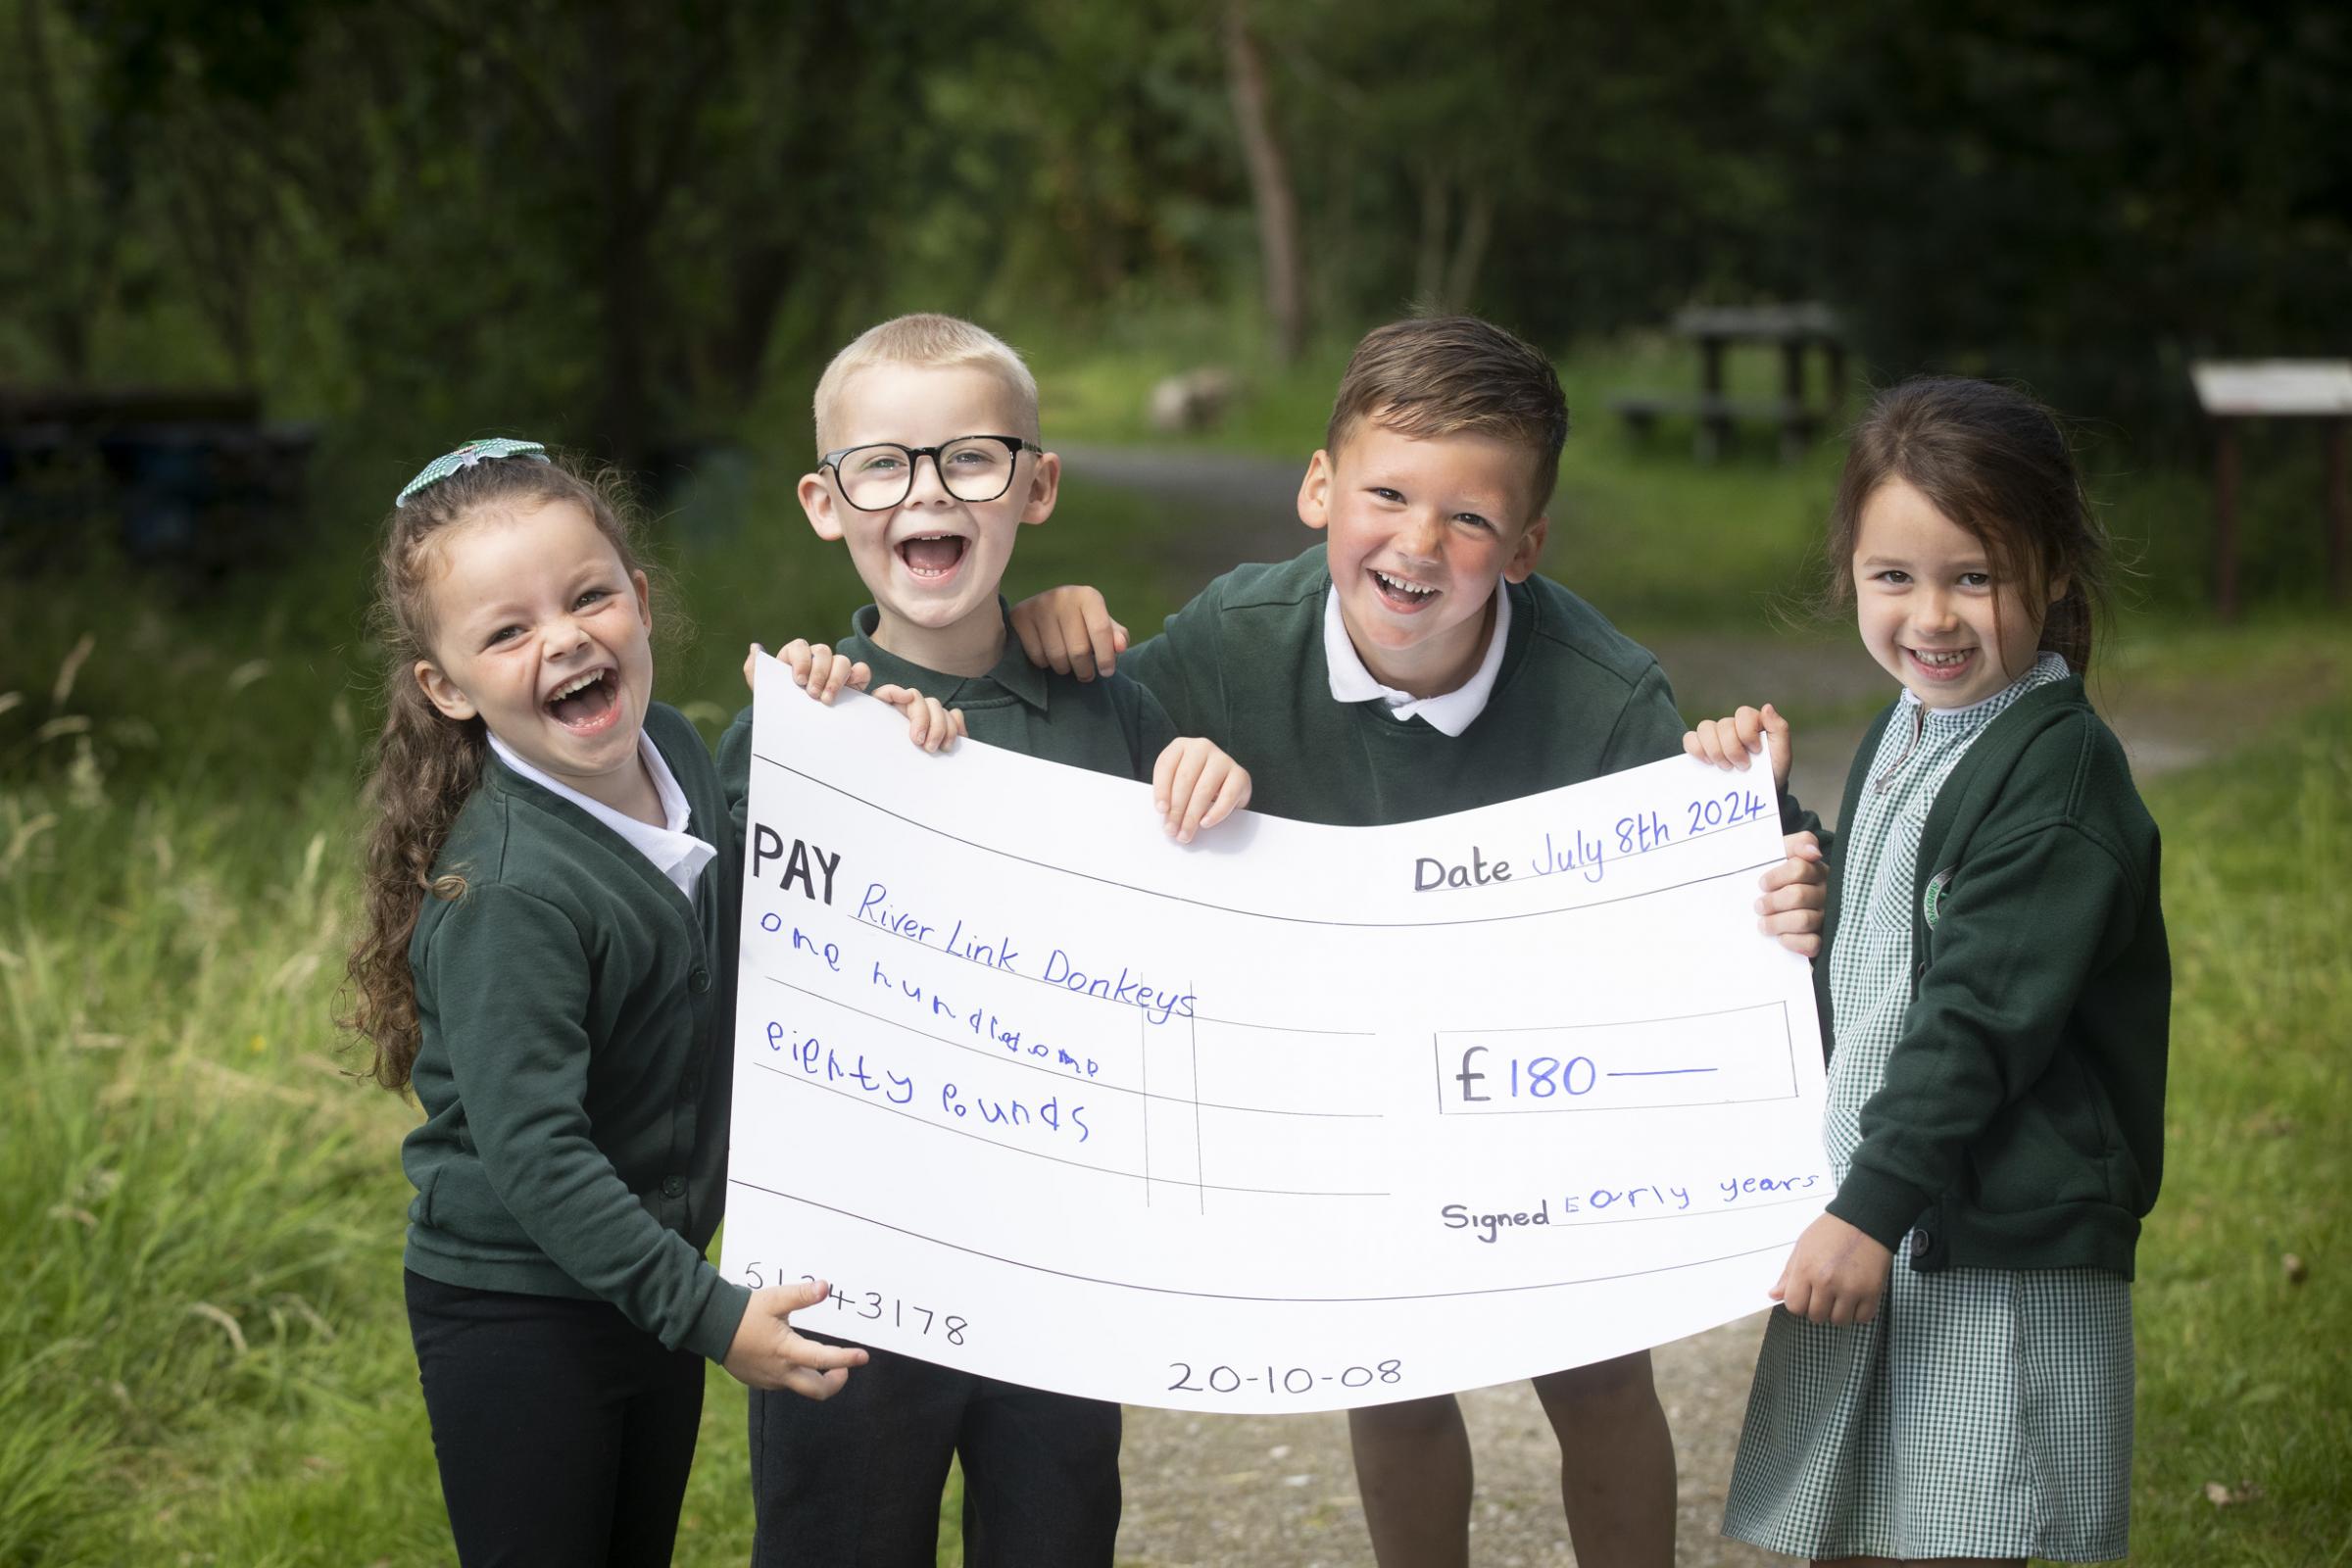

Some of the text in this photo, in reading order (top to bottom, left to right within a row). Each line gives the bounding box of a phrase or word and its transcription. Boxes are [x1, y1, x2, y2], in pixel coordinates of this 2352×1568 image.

[1414, 790, 1767, 892] Date July 8th 2024
[753, 821, 1199, 1025] PAY River Link Donkeys
[760, 911, 841, 972] one
[1441, 1199, 1551, 1244] Signed
[1720, 1174, 1820, 1202] years
[745, 1261, 969, 1347] 5143178
[1167, 1358, 1402, 1395] 20-10-08
